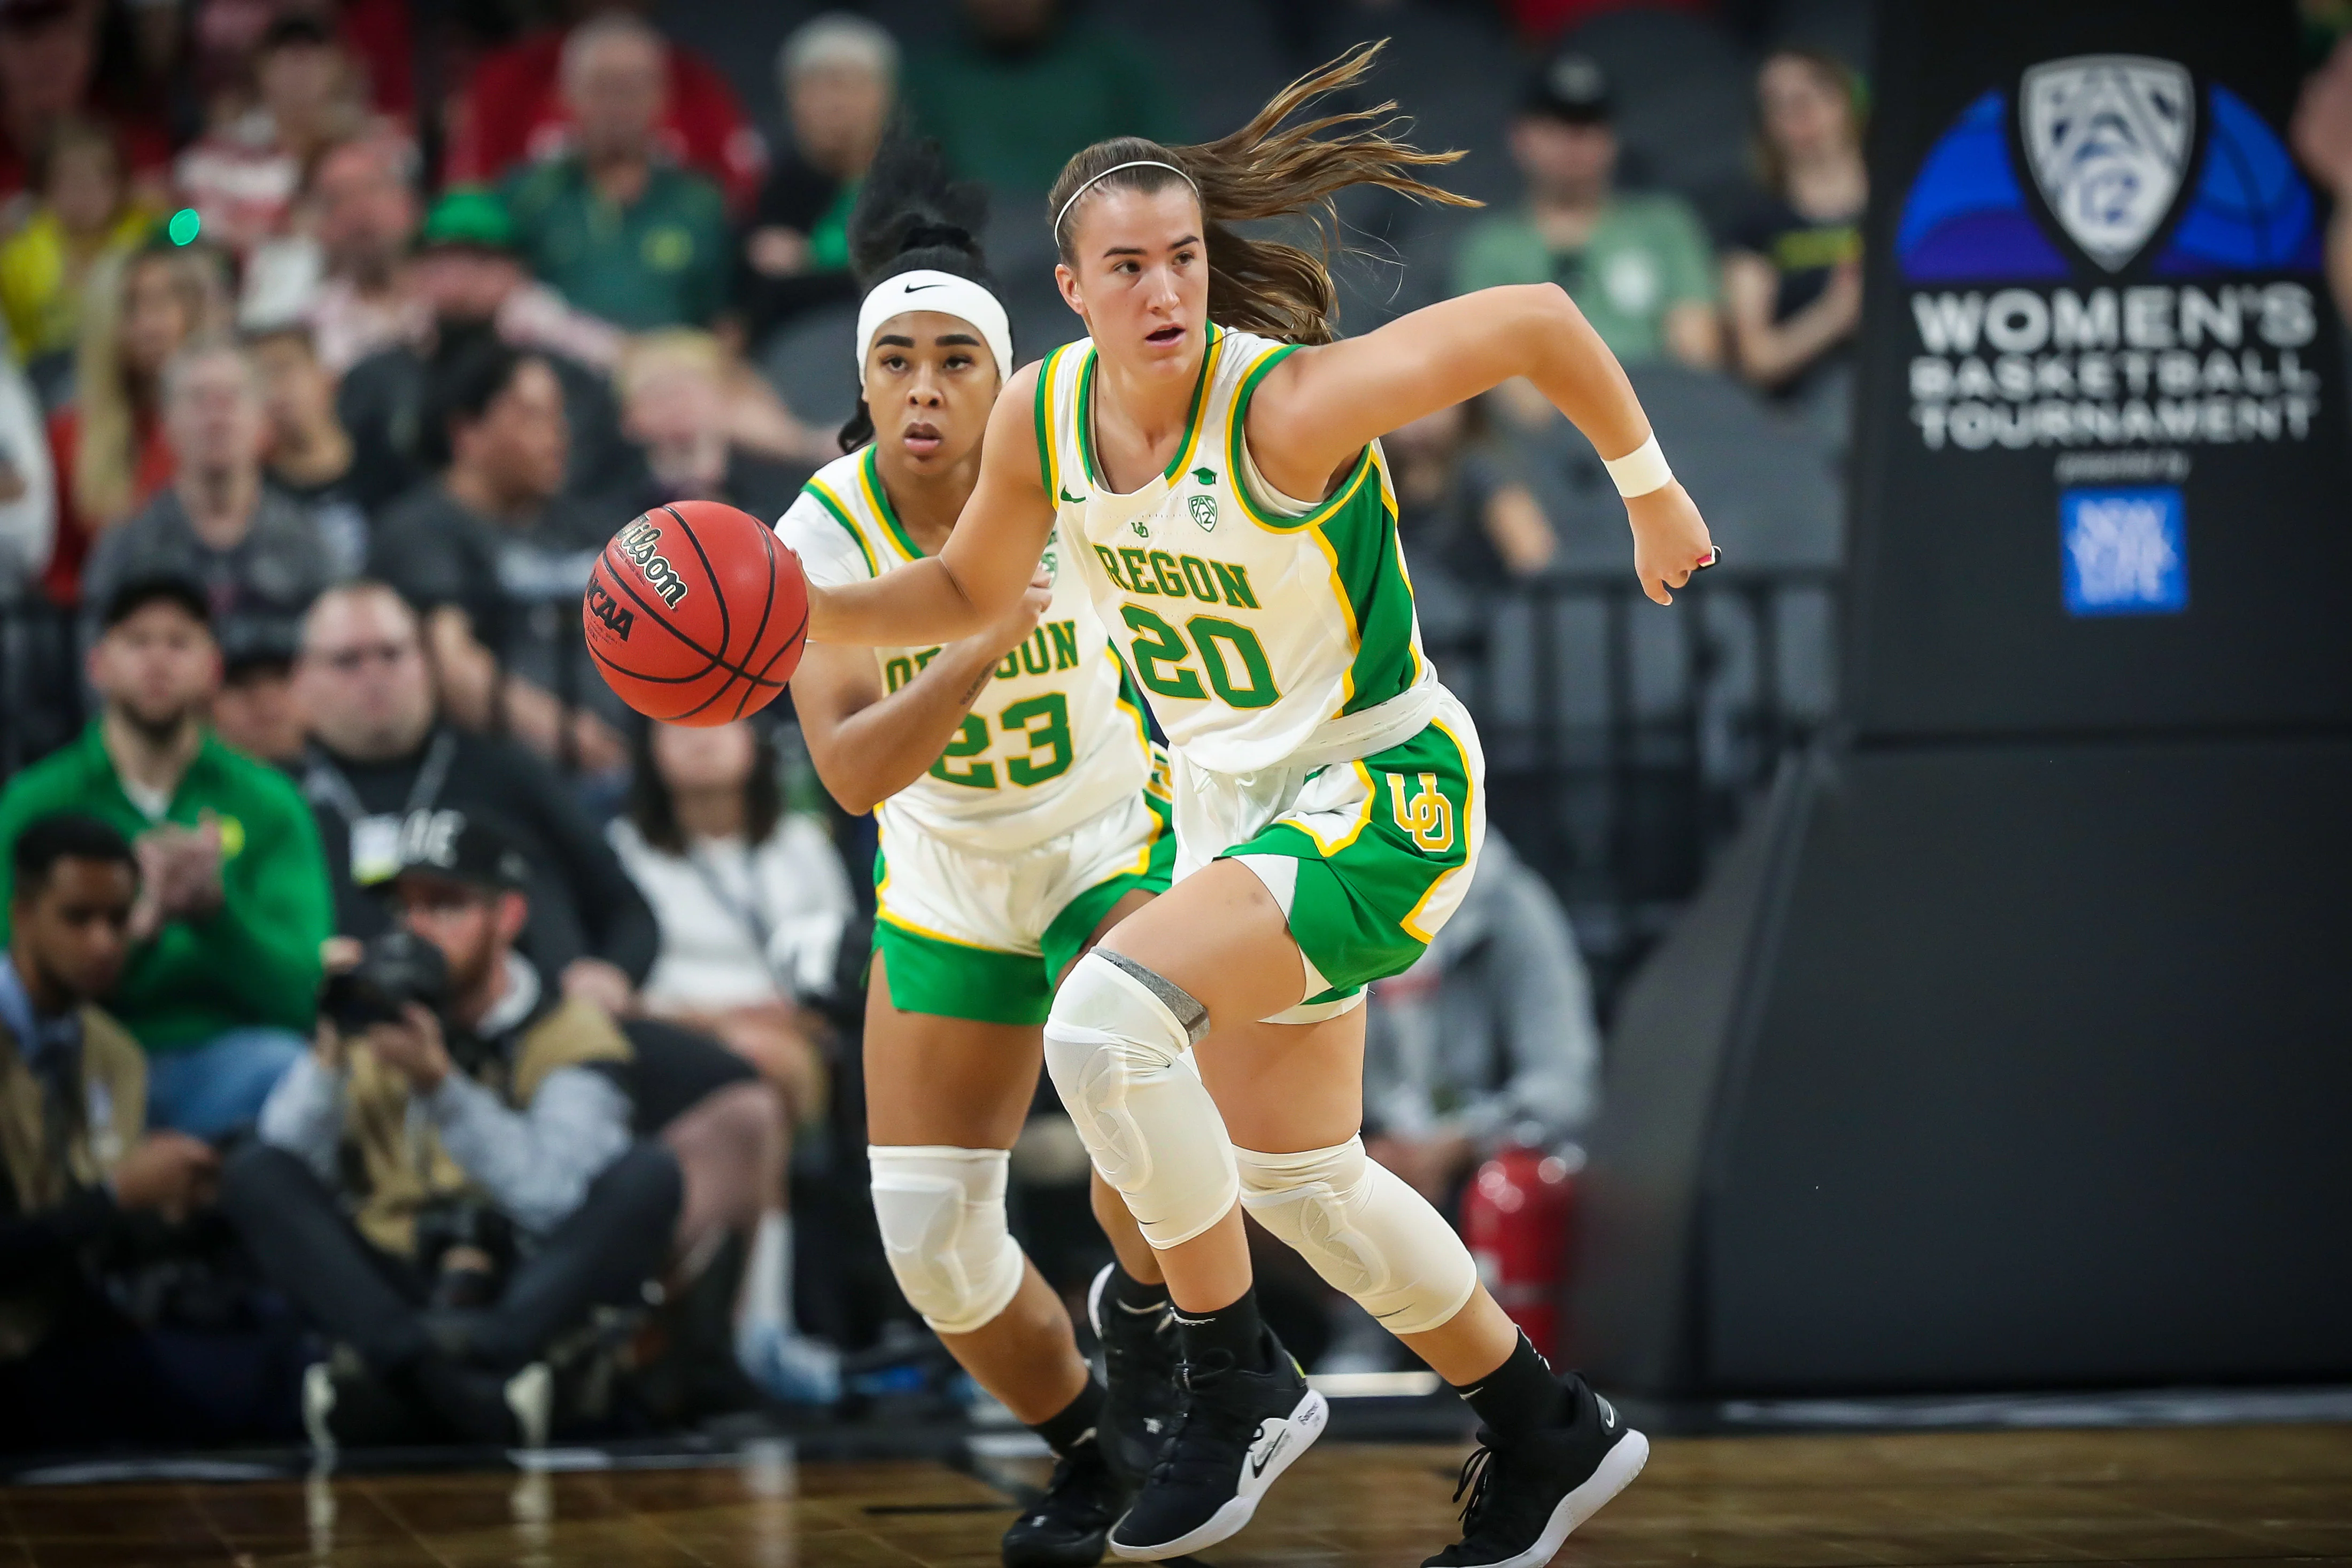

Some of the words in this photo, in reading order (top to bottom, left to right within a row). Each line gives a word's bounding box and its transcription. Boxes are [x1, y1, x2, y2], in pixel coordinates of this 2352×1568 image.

[1912, 282, 2316, 354] WOMEN'S
[1909, 348, 2319, 402] BASKETBALL
[1910, 395, 2318, 451] TOURNAMENT
[1090, 542, 1262, 610] REGON
[1119, 601, 1283, 710] 20
[929, 692, 1074, 790] 23
